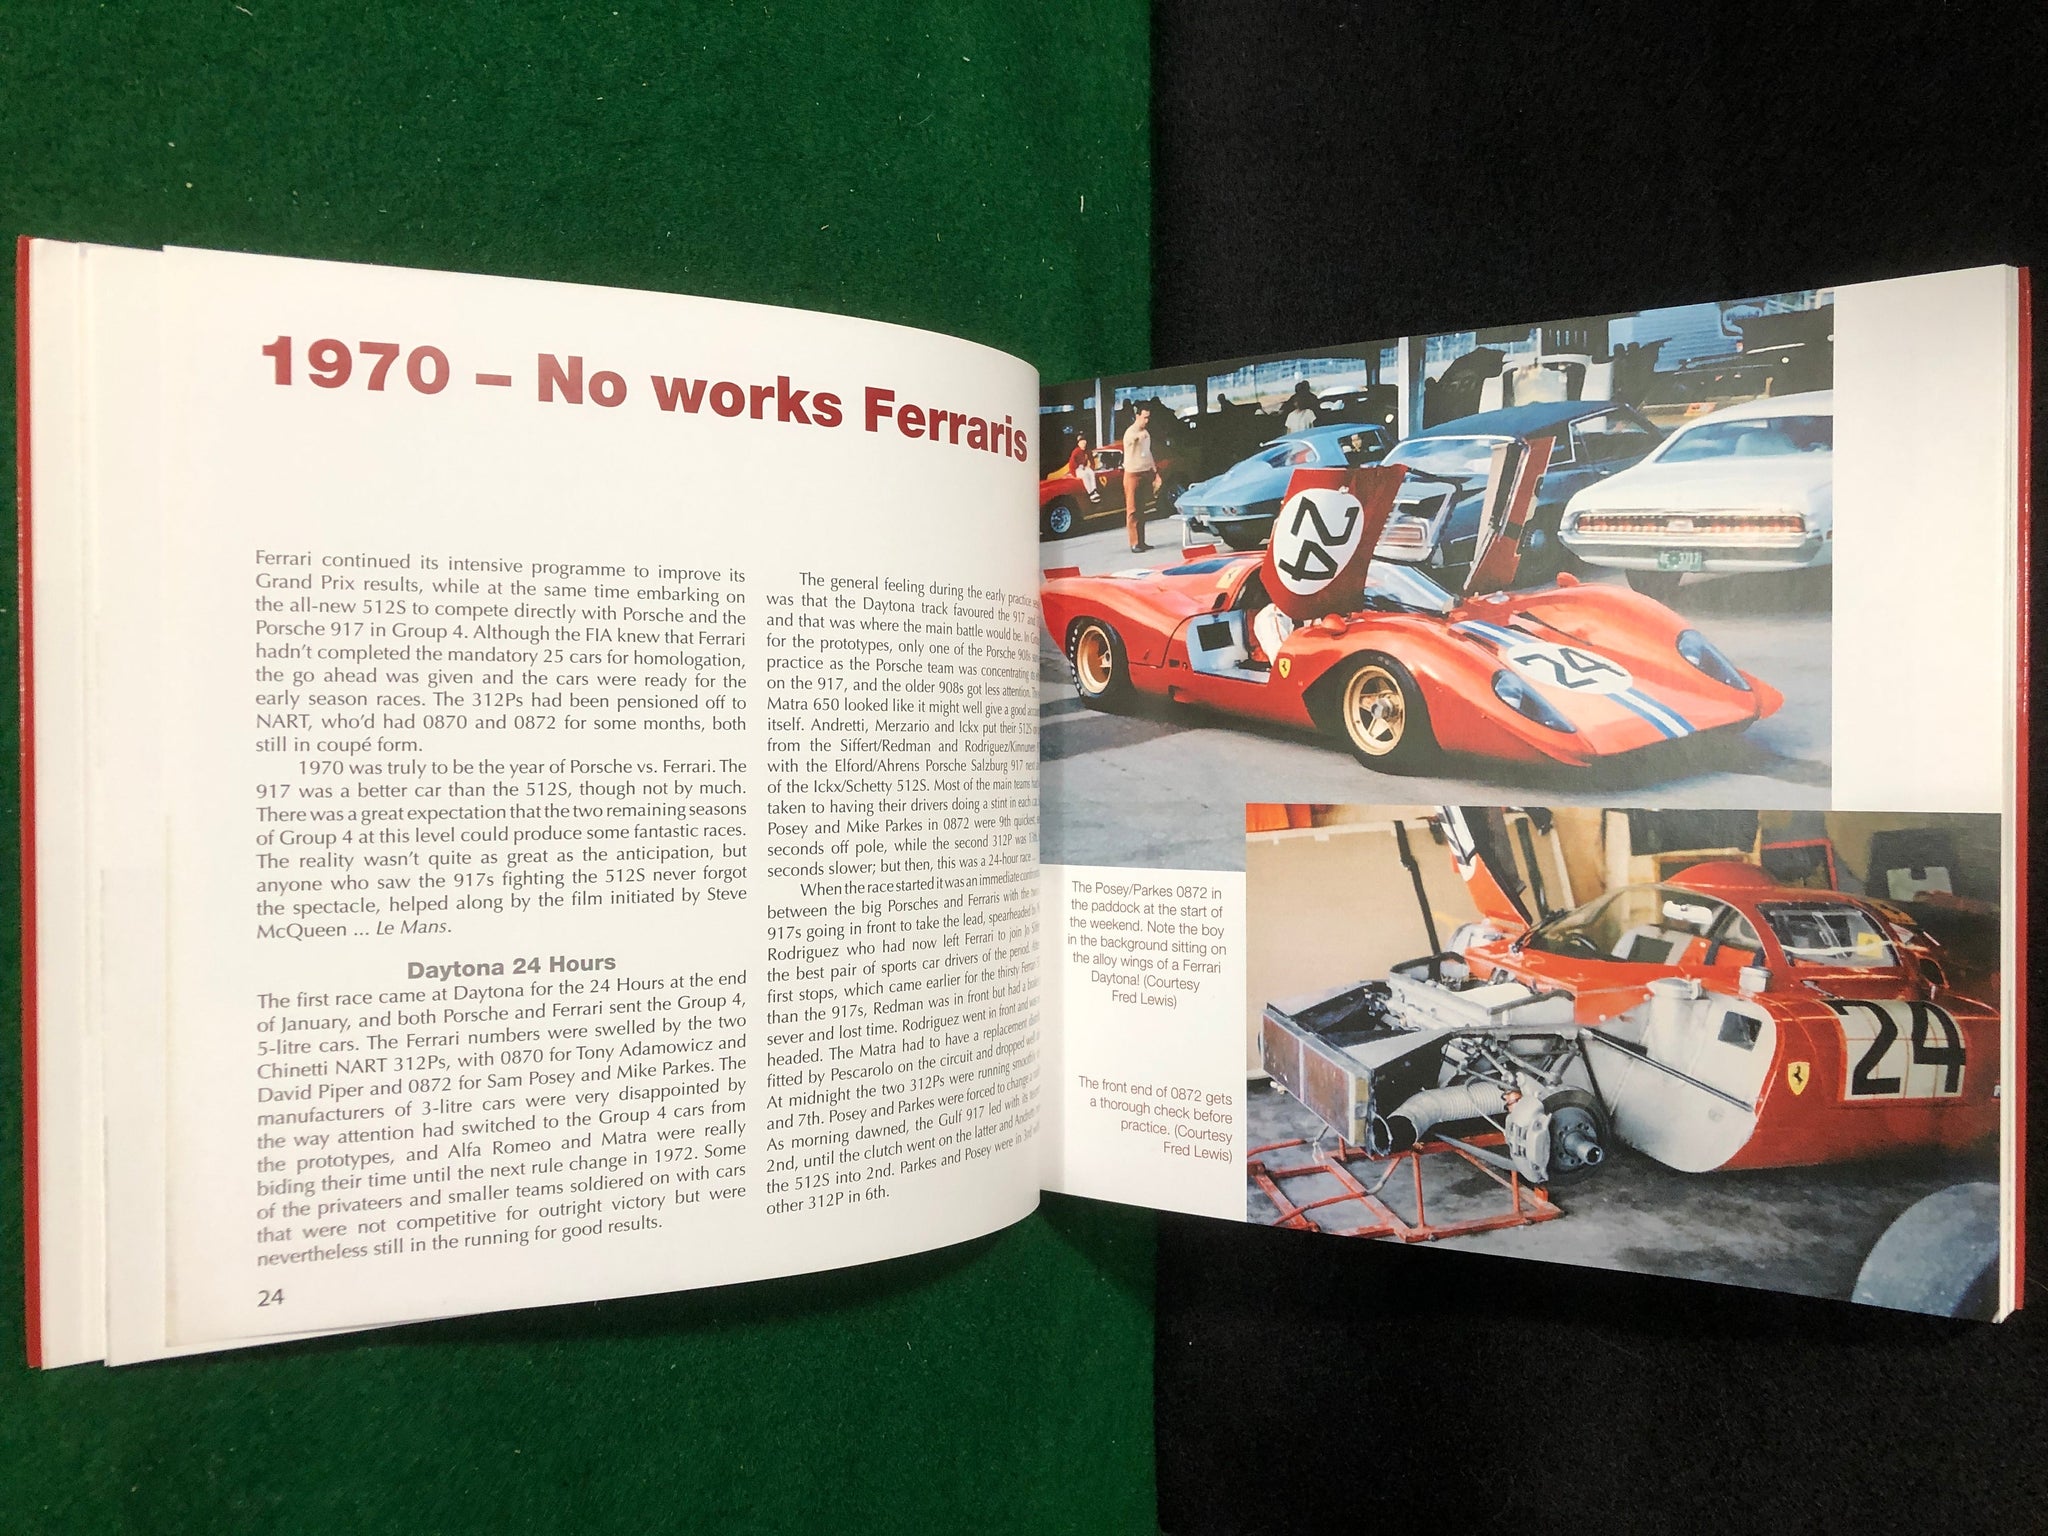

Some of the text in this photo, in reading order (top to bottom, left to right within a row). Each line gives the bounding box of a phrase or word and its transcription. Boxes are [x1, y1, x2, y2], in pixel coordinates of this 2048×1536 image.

[262, 335, 450, 394] 1970
[538, 353, 627, 406] No
[651, 375, 843, 428] works
[864, 386, 1027, 462] Ferraris
[1278, 496, 1360, 582] 24
[256, 550, 745, 584] Ferrari continued its intensive programme to improve its
[256, 573, 745, 607] Grand Prix results, while at the same time embarking on
[766, 593, 1024, 622] was that the Daytona track favoured the 917
[1513, 648, 1626, 689] 24
[256, 779, 746, 800] 917 was a better car than the 512S, though not by much.
[768, 834, 1026, 857] seconds off pole, while the second 312P was
[1072, 881, 1221, 899] The Posey/Parkes 0872 in
[1071, 899, 1222, 918] the paddock at the start of
[257, 923, 346, 941] McQueen
[376, 921, 394, 935] Le
[400, 920, 451, 934] Mans.
[1070, 916, 1224, 939] the weekend. Note the boy
[1068, 935, 1226, 957] in the background sitting on
[408, 955, 616, 982] Daytona 24 Hours
[1073, 952, 1221, 973] the alloy wings of a Ferrari
[1092, 970, 1200, 993] Daytona! (Courtesy
[1112, 990, 1177, 1009] Fred Lewis)
[257, 1016, 746, 1056] 5-litre cars. The Ferrari numbers were swelled by the two
[768, 1019, 1027, 1066] headed. The Matra had to have a replacement
[1827, 1000, 1967, 1096] 24
[1078, 1075, 1232, 1106] The front end of 0872 gets
[1090, 1097, 1232, 1124] a thorough check before
[257, 1100, 745, 1150] the way attention had switched to the Group 4 cars from
[1121, 1120, 1232, 1145] practice. (Courtesy
[1164, 1141, 1232, 1164] Fred Lewis)
[767, 1185, 889, 1214] other 312P in 6th.
[258, 1215, 662, 1266] nevertheless still in the running for good results.
[256, 1288, 285, 1307] 24
